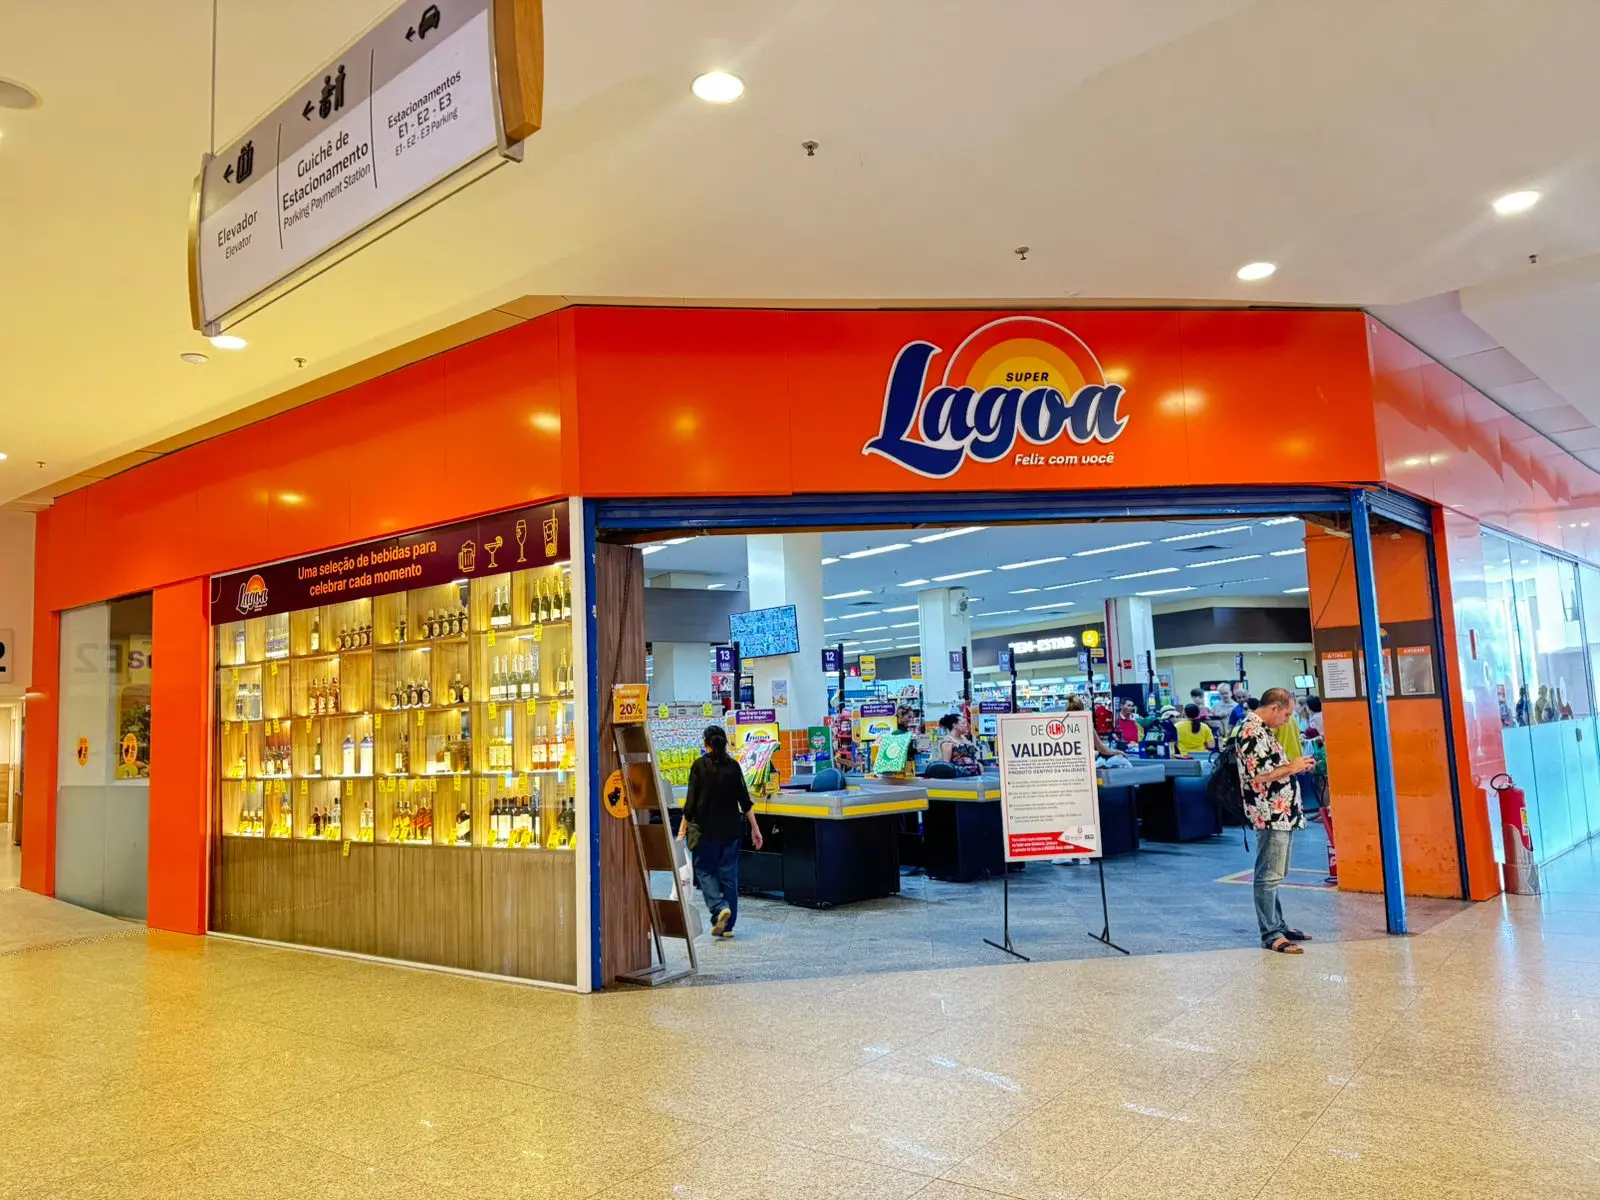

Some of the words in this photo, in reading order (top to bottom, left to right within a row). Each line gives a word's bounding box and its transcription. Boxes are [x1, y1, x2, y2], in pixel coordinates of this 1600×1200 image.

[388, 71, 461, 129] Estacionamentos
[398, 121, 409, 139] E1
[417, 107, 430, 126] E2
[439, 92, 452, 112] E3
[395, 143, 403, 156] E1
[406, 134, 416, 149] E2
[420, 124, 430, 140] E3
[430, 106, 458, 133] Parking
[297, 143, 333, 178] Guichê
[336, 132, 350, 156] de
[282, 142, 369, 212] Estacionamento
[283, 201, 310, 230] Parking
[310, 183, 342, 218] Payment
[344, 163, 371, 192] Station
[217, 209, 258, 248] Elevador
[225, 234, 252, 260] Elevator
[1005, 372, 1049, 382] SUPER
[861, 340, 1130, 479] Lagoa
[1014, 452, 1045, 466] Feliz
[1048, 454, 1078, 465] com
[1081, 452, 1114, 465] você
[298, 564, 318, 580] Uma
[319, 556, 356, 577] seleção
[356, 553, 369, 567] de
[370, 545, 411, 566] bebidas
[412, 540, 437, 561] para
[309, 578, 347, 597] celebrar
[348, 573, 372, 589] cada
[373, 563, 423, 585] momento
[235, 582, 269, 615] Lagoa
[720, 650, 730, 660] 13
[825, 651, 834, 661] 12
[952, 653, 959, 662] 11
[619, 703, 643, 715] 20%
[1030, 724, 1044, 736] DE
[1067, 723, 1080, 733] NA
[1011, 741, 1082, 758] VALIDADE
